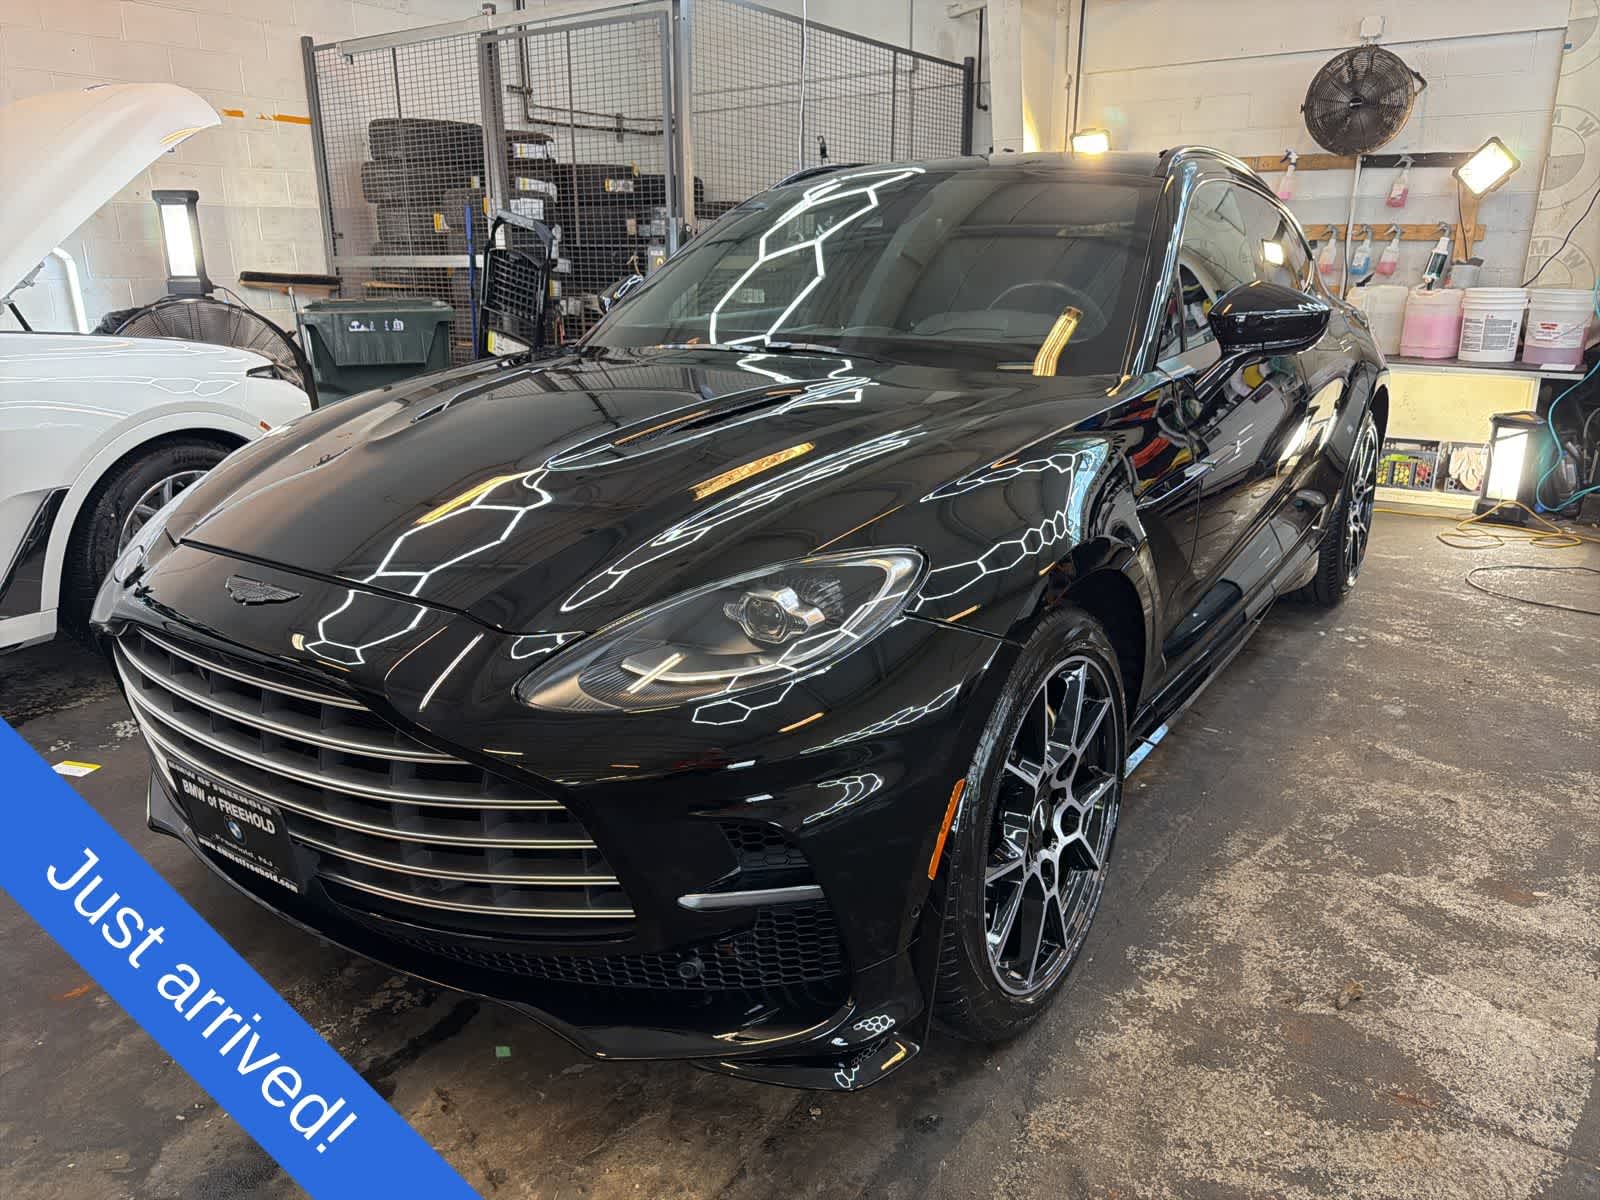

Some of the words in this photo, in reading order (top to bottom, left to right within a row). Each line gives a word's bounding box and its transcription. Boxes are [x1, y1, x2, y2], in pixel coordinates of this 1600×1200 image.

[182, 779, 206, 802] BMW
[207, 795, 218, 809] of
[219, 799, 276, 835] FREEHOLD
